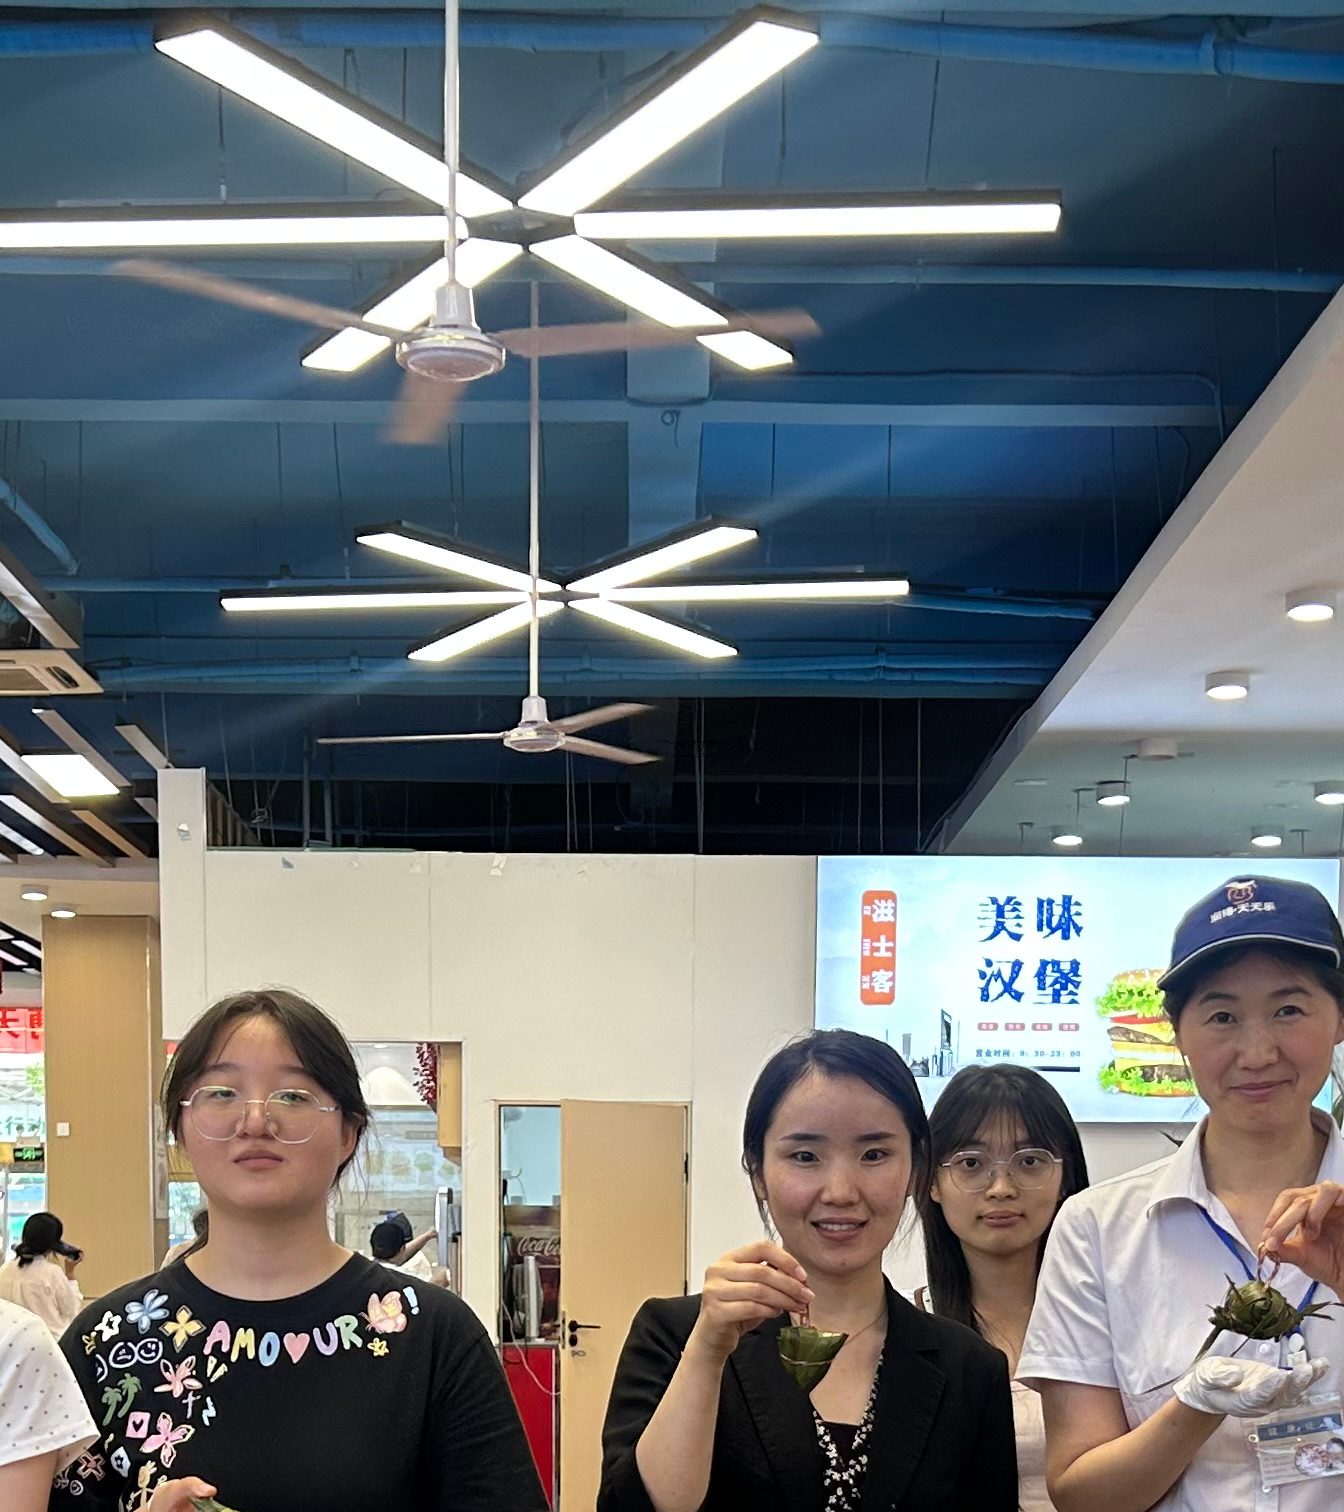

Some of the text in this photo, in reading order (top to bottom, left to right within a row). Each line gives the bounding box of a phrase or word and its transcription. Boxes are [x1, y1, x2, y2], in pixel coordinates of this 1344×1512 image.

[976, 894, 1084, 942] 美味
[871, 898, 895, 993] 滋士客
[976, 956, 1082, 1005] 汉堡
[203, 1315, 364, 1367] AMOUR
